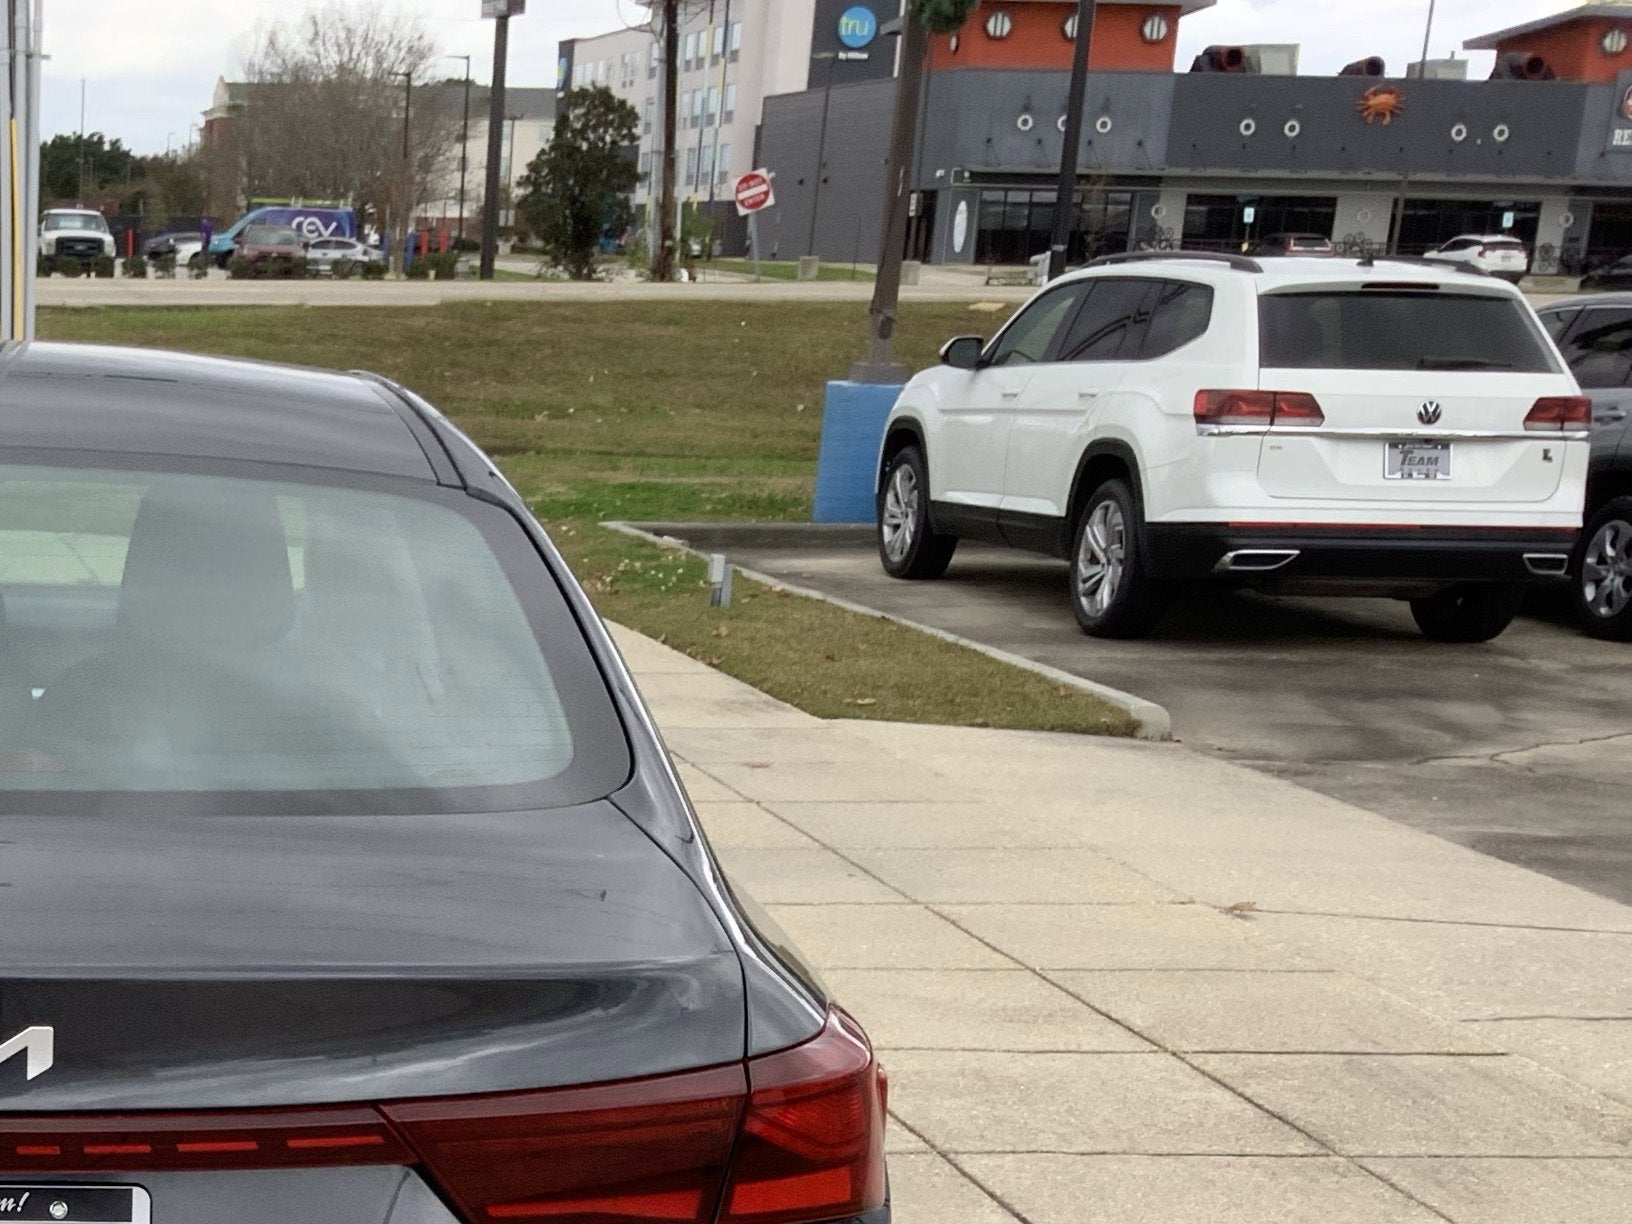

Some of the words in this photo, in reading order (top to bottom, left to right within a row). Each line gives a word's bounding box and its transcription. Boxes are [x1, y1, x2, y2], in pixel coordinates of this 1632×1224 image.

[840, 16, 869, 36] tru
[291, 216, 338, 238] rev
[1399, 449, 1440, 466] TEAM
